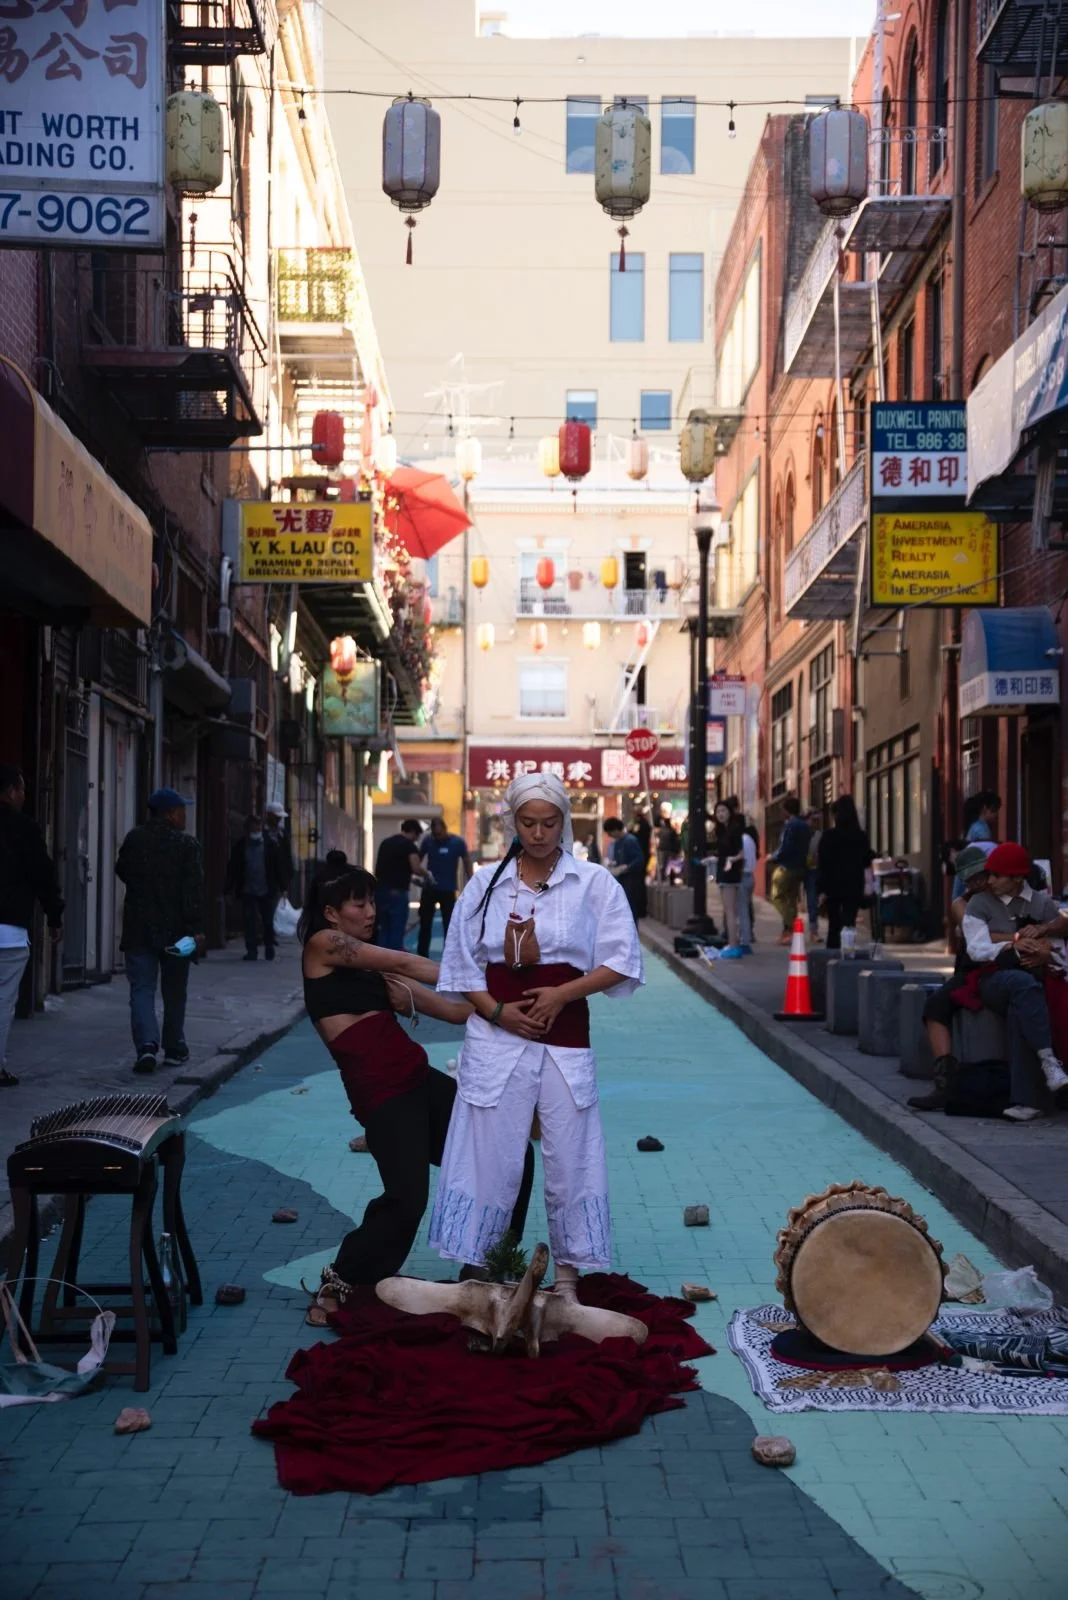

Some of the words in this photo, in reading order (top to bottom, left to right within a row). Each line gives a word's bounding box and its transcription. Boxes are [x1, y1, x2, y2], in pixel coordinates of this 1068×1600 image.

[42, 112, 140, 141] WORTH
[0, 141, 75, 169] DING
[89, 144, 135, 171] CO.
[0, 193, 150, 235] 7-9062
[876, 409, 924, 429] DUXWELL
[886, 432, 915, 449] TEL.
[880, 456, 967, 487] 德和印
[249, 540, 262, 555] Y.
[268, 540, 285, 555] K.
[290, 540, 326, 555] LAU
[332, 540, 360, 555] CO.
[892, 534, 965, 546] INVESTMENT
[254, 559, 302, 567] FRAMING
[891, 550, 936, 562] REALTY
[248, 568, 296, 576] ORIENTAL
[303, 568, 360, 576] FURNITURE
[626, 736, 657, 752] STOP
[649, 764, 687, 781] HON'S
